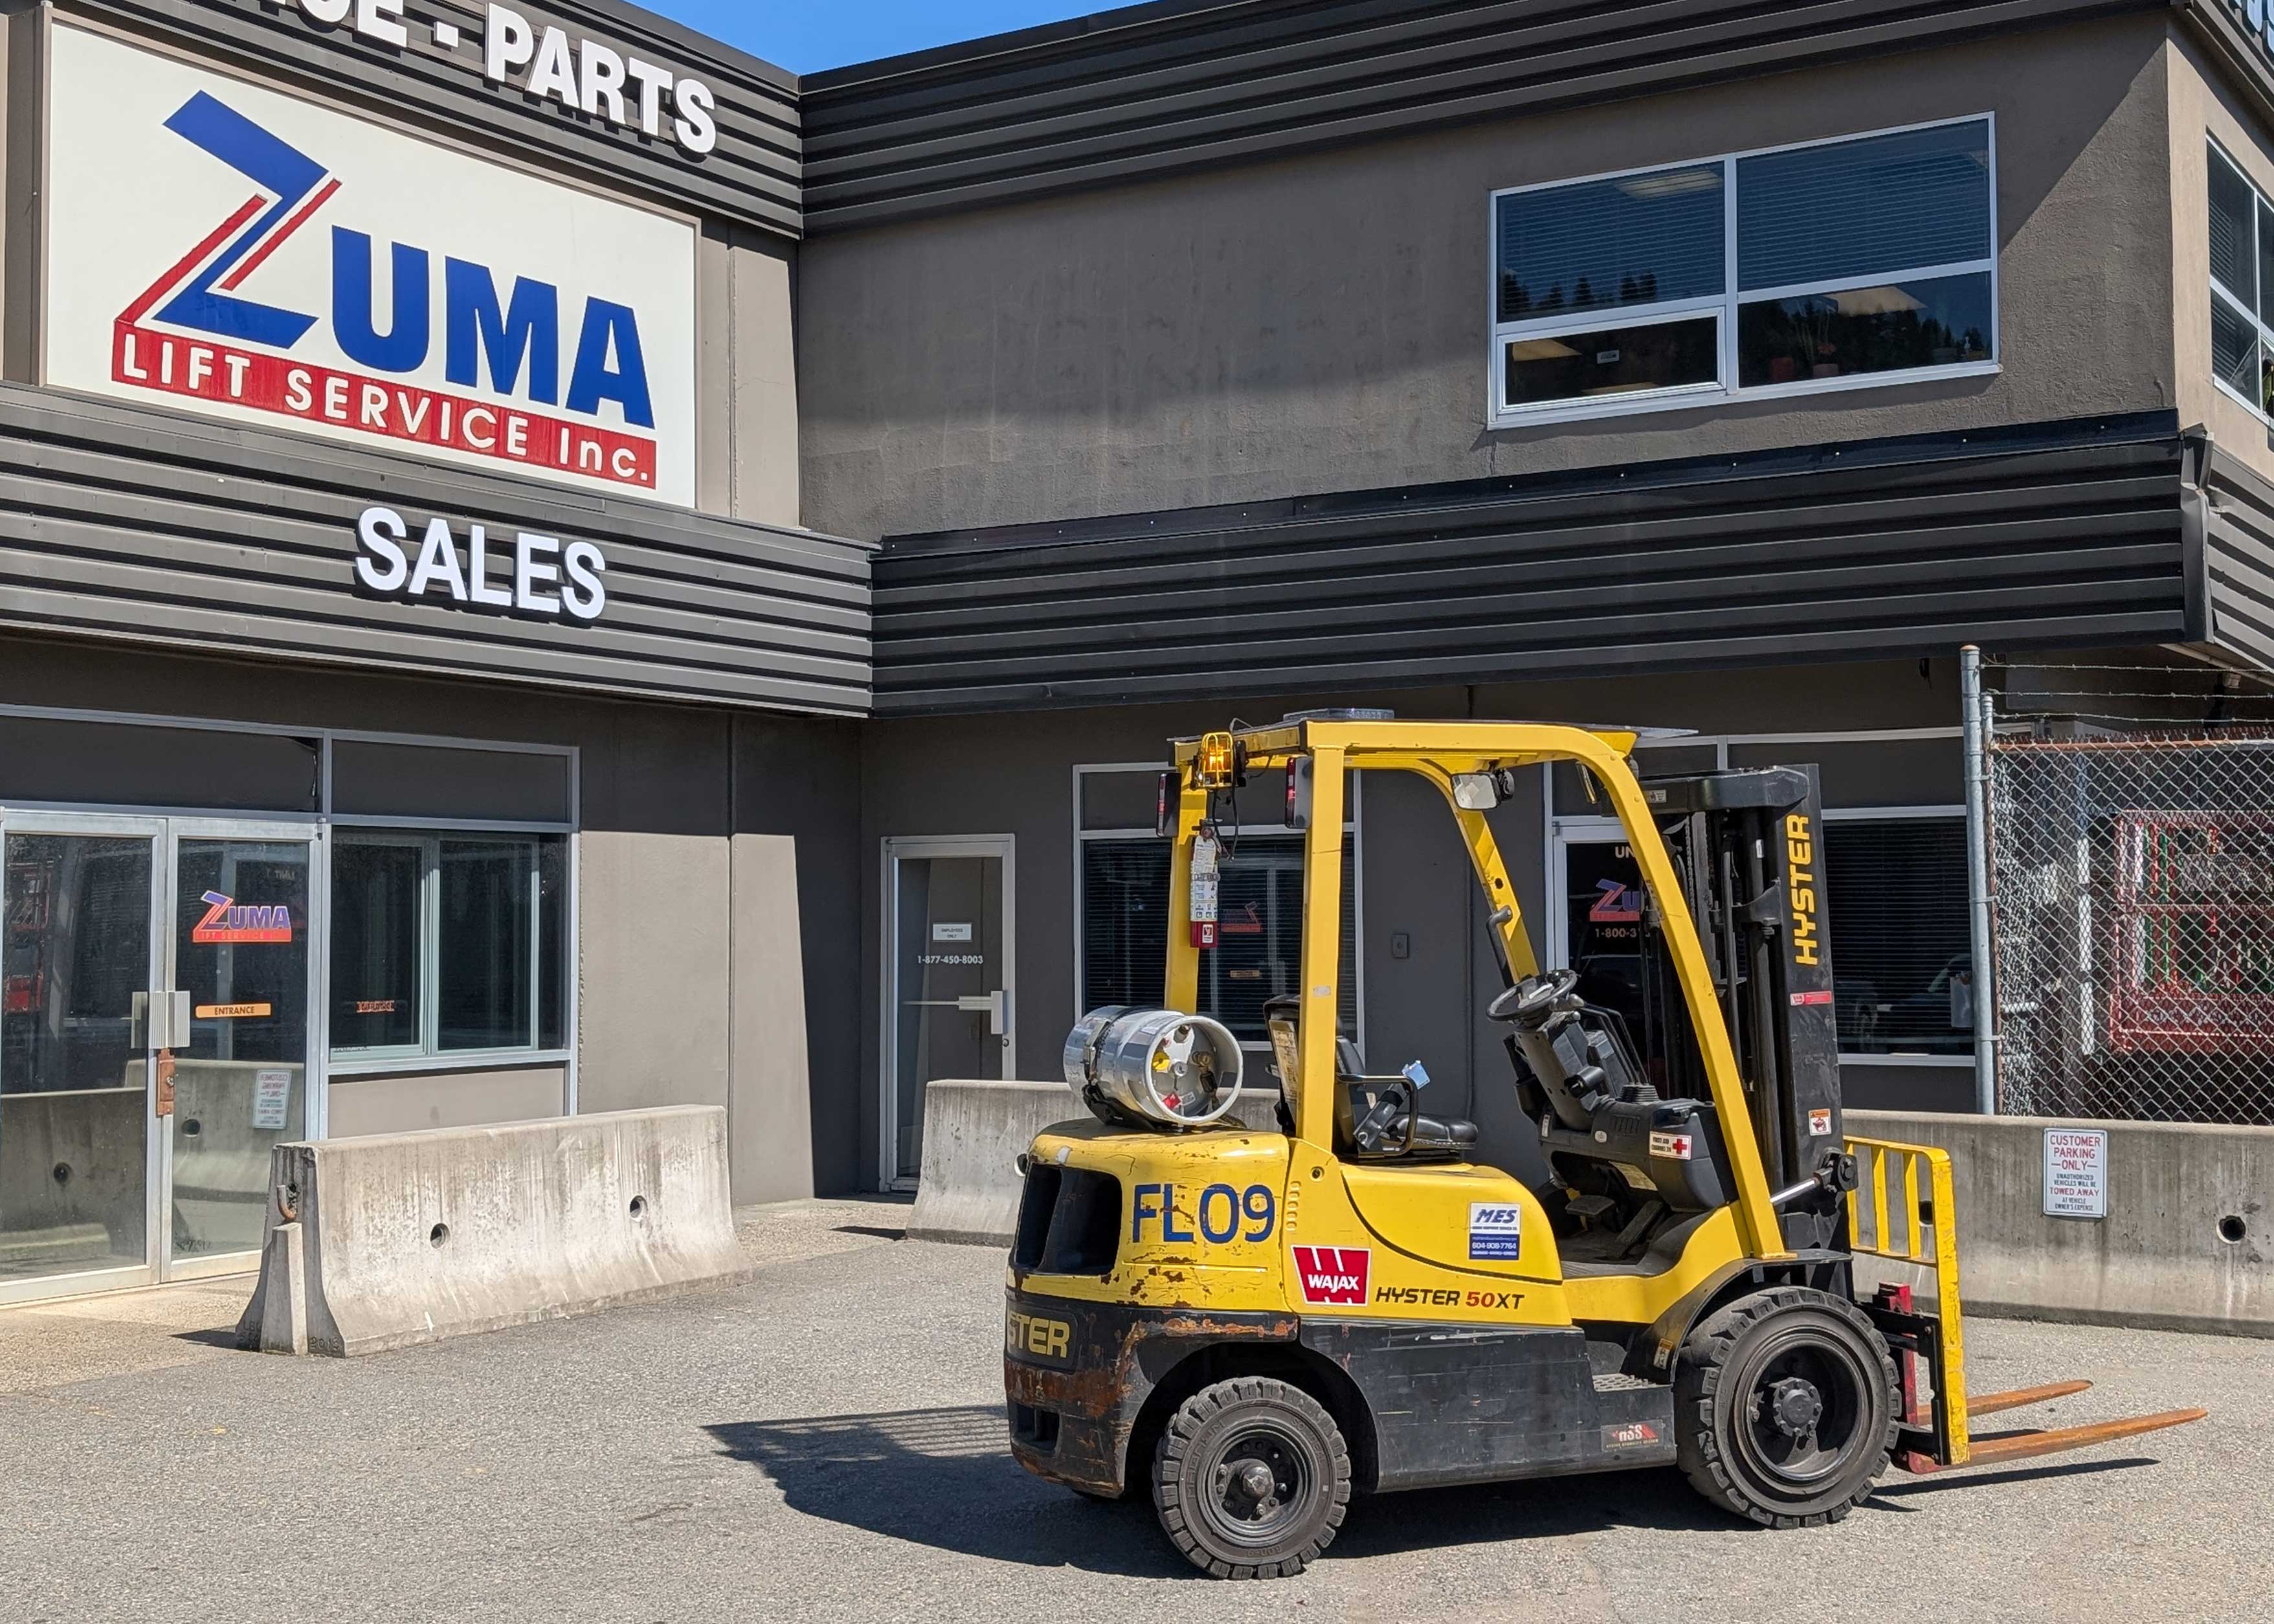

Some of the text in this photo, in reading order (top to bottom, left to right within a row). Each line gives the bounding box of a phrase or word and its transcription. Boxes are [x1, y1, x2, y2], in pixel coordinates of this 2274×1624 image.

[485, 3, 717, 153] PARTS
[149, 89, 656, 430] ZUMA
[123, 333, 649, 482] LIFT SERVICE Inc.
[355, 507, 606, 619] SALES
[1787, 814, 1818, 965] HYSTER
[195, 889, 291, 930] ZUMA
[196, 931, 216, 940] LIFT
[221, 931, 265, 940] SERVICE
[917, 955, 983, 964] 1-877-450-8003
[214, 1006, 255, 1016] ENTRANCE
[2049, 1134, 2101, 1147] CUSTOMER
[2053, 1147, 2095, 1159] PARKING
[2062, 1159, 2088, 1170] ONLY
[2056, 1173, 2094, 1181] UNAUTHORIZED
[2049, 1187, 2099, 1197] TOWED AWAY
[1475, 1209, 1517, 1224] MES
[1308, 1274, 1359, 1293] WAJAX
[1376, 1287, 1525, 1309] HYSTER 50XT
